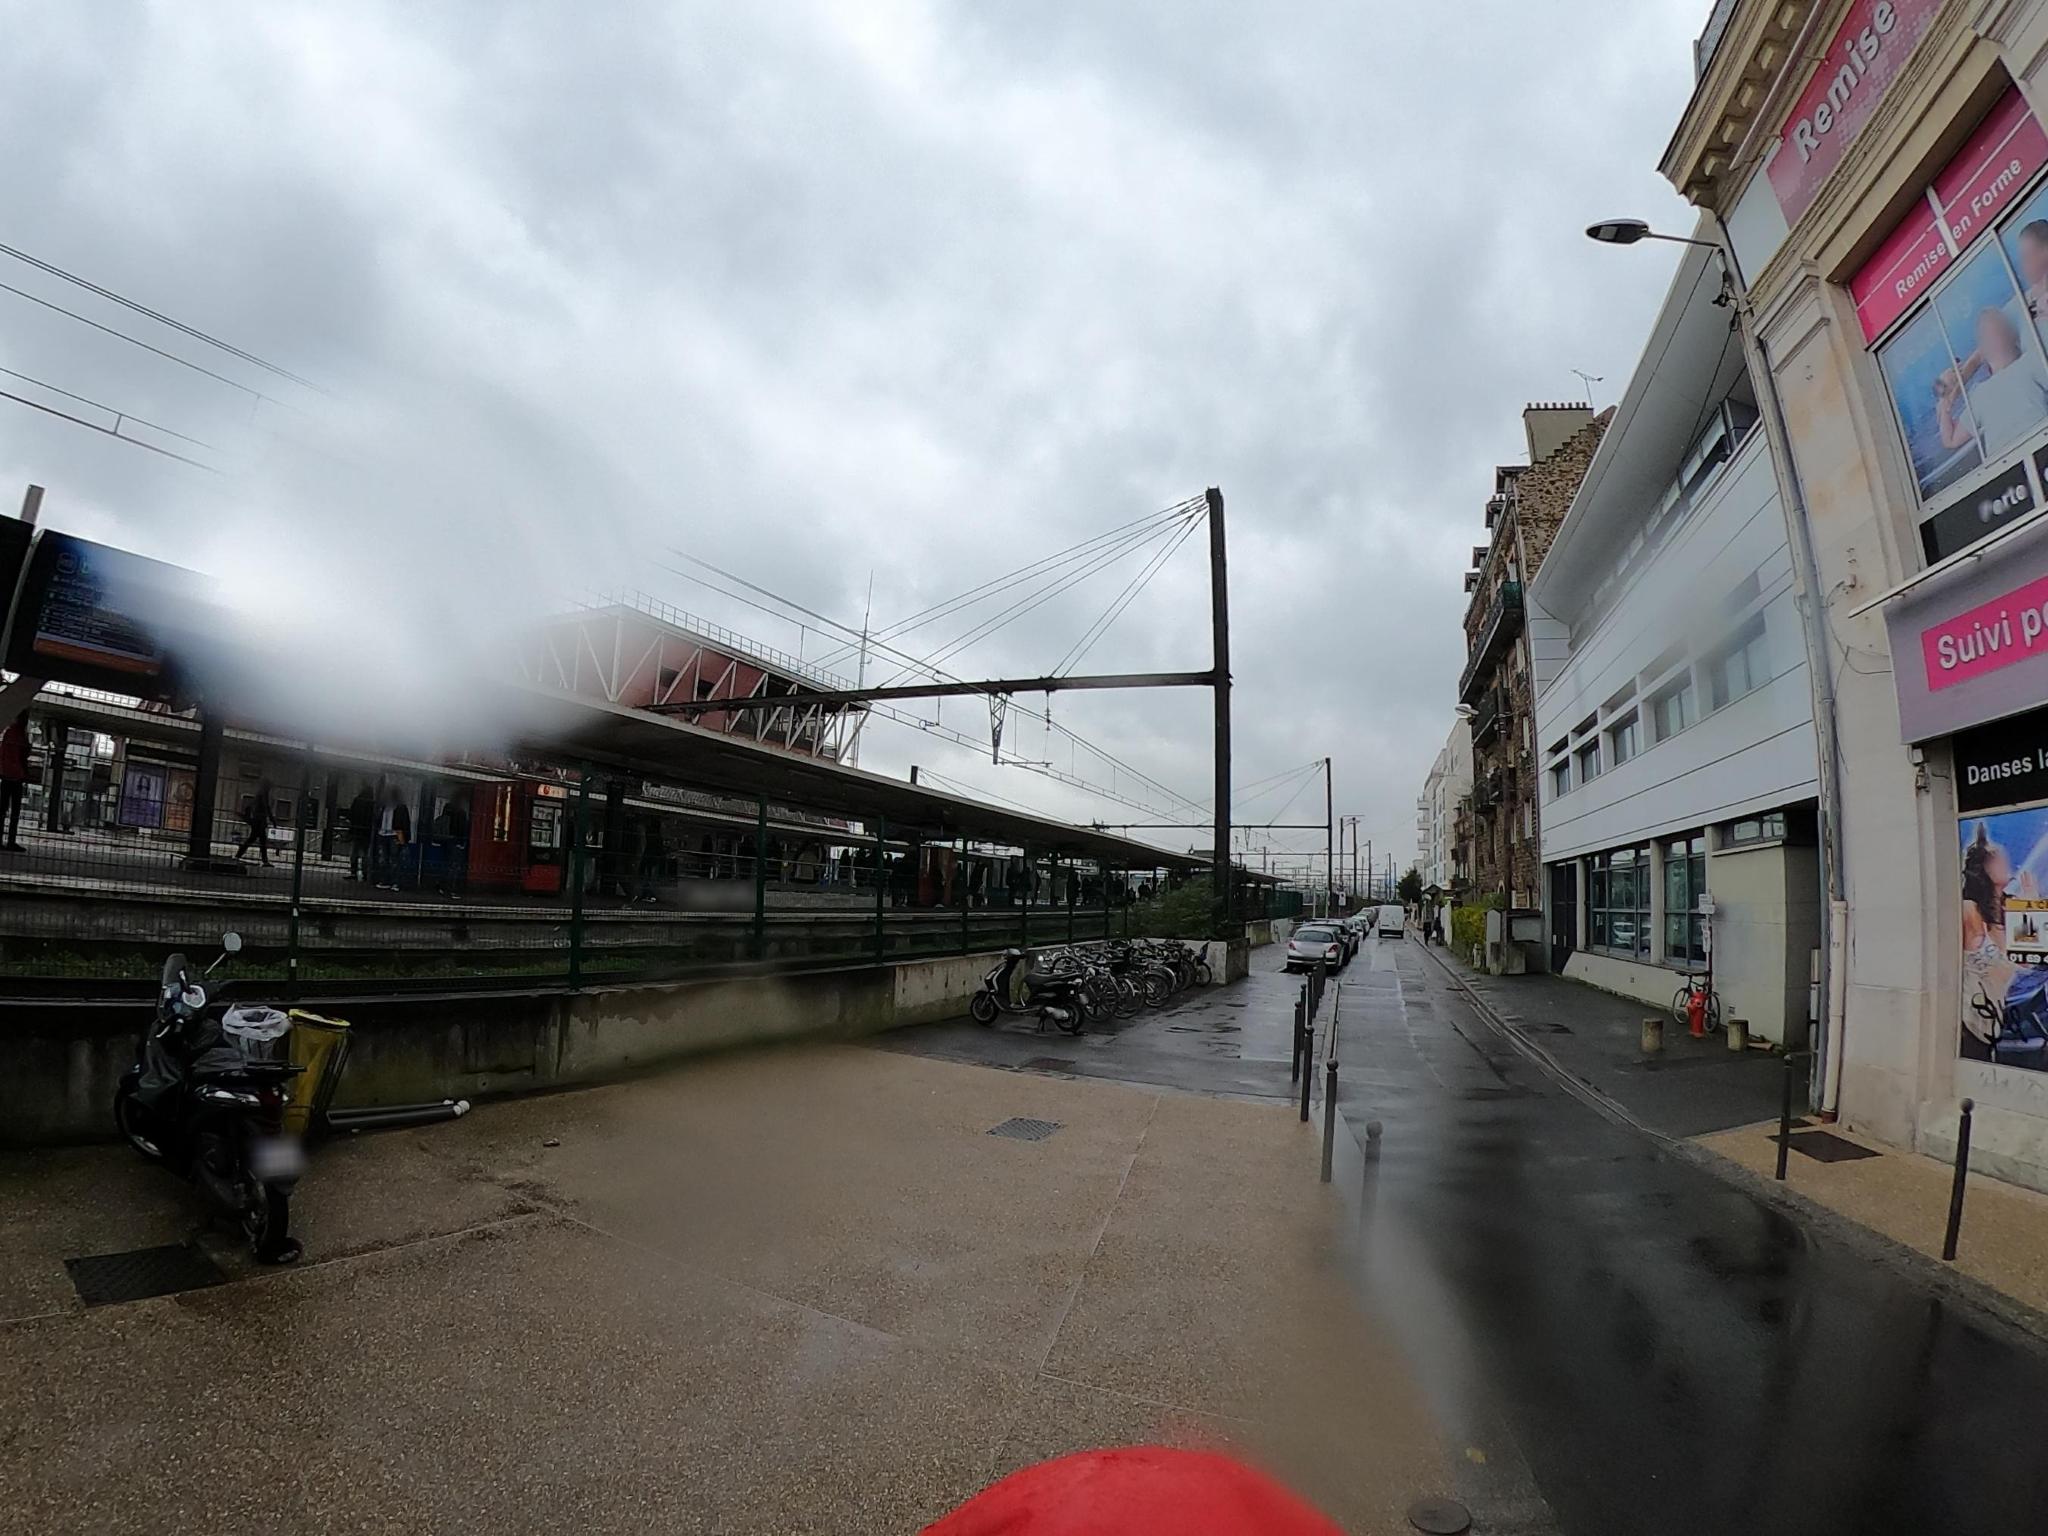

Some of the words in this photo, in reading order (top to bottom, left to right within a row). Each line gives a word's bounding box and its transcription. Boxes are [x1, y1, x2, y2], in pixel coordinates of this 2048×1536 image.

[1792, 0, 1897, 163] Remise
[1895, 242, 1947, 298] Remise
[1951, 215, 1972, 240] en
[1971, 158, 2022, 218] Forme
[1938, 610, 2013, 670] Suivi
[1967, 756, 2033, 785] Danses
